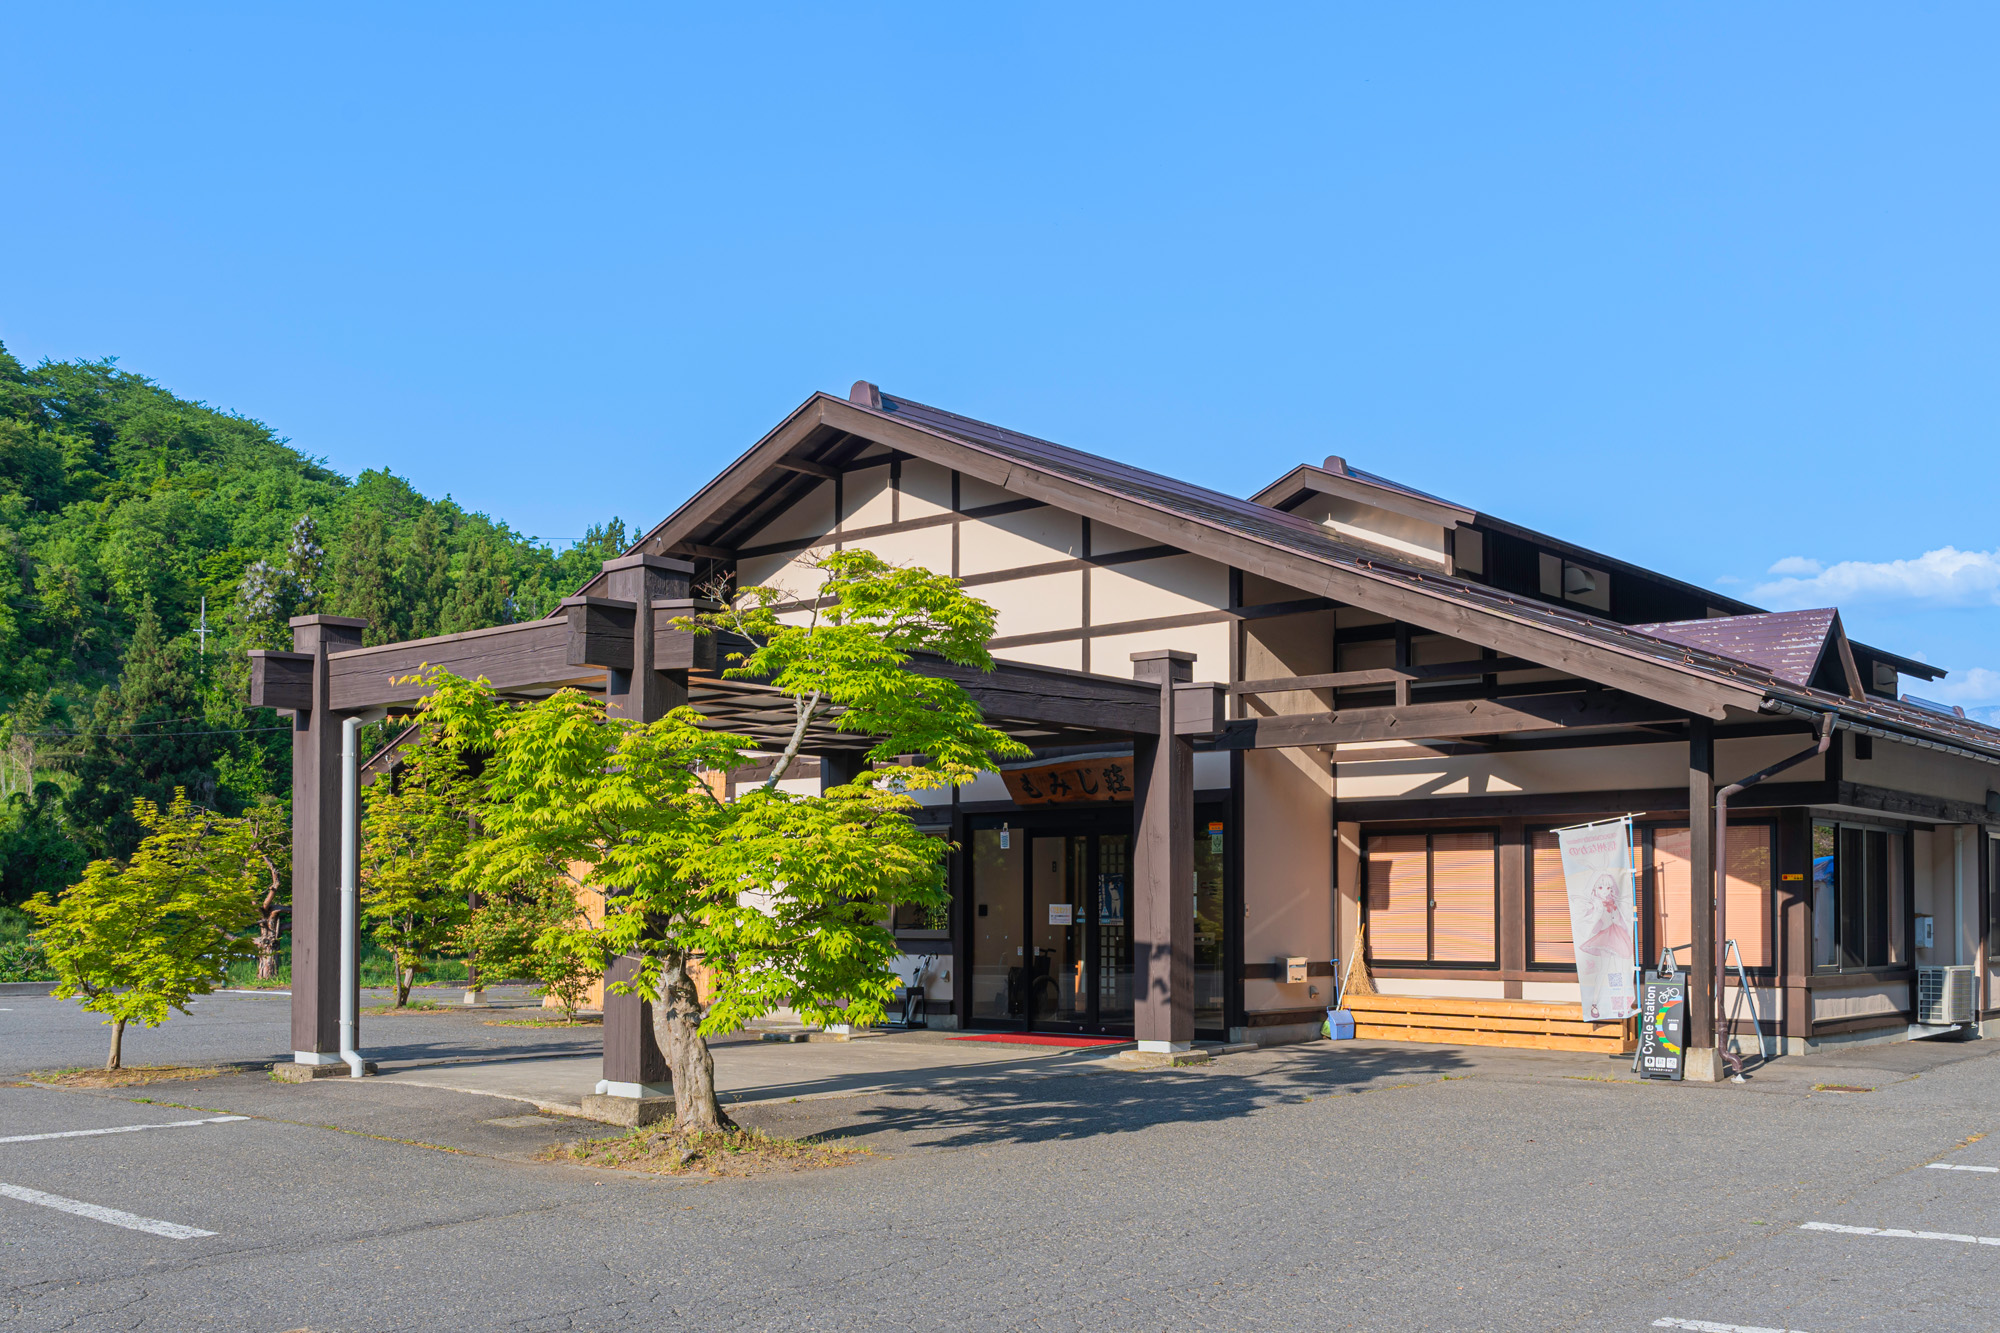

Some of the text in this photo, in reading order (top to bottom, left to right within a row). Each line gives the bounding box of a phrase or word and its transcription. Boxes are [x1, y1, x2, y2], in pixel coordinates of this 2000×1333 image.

[1019, 763, 1132, 799] もみじ荘
[1642, 985, 1656, 1055] Cycle Station
